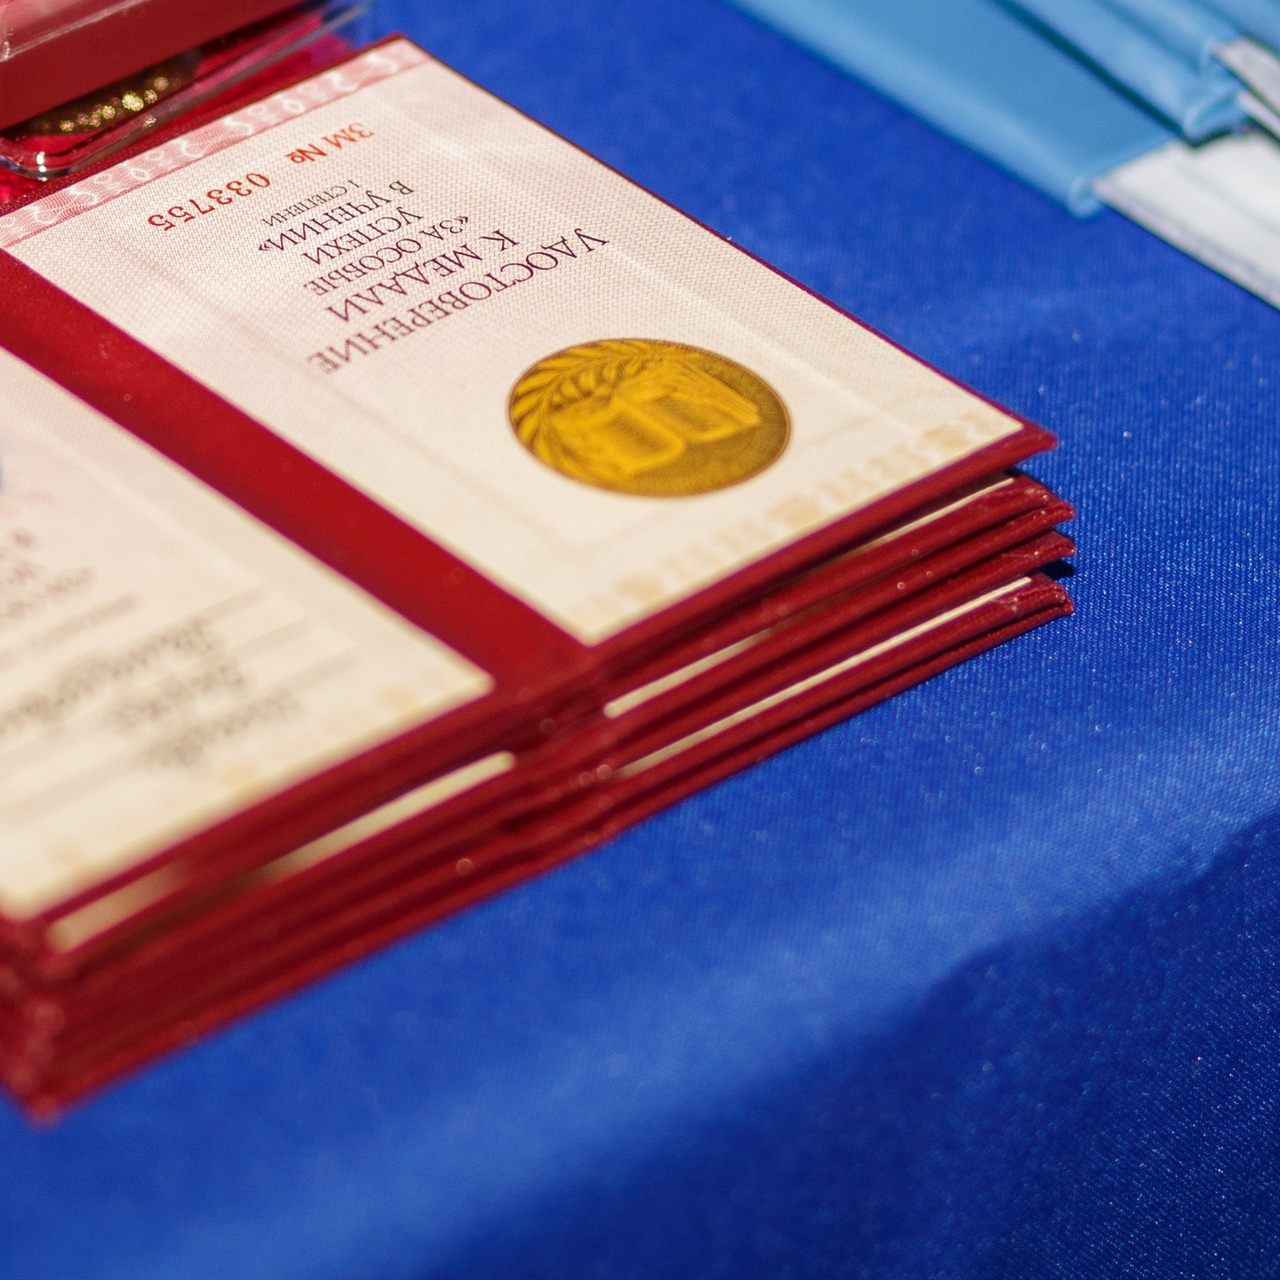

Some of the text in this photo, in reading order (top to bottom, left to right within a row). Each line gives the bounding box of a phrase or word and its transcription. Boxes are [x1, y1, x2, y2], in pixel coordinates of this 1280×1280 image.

[285, 143, 328, 164] №
[147, 172, 271, 232] 033755
[261, 185, 349, 227] СТЕПЕНИ
[388, 180, 415, 196] В
[301, 206, 424, 265] УСПЕХИ
[303, 237, 423, 296] ОСОБЫЕ
[326, 229, 520, 322] К МЕДАЛИ
[307, 228, 610, 373] УДОСТОВЕРЕНИЕ
